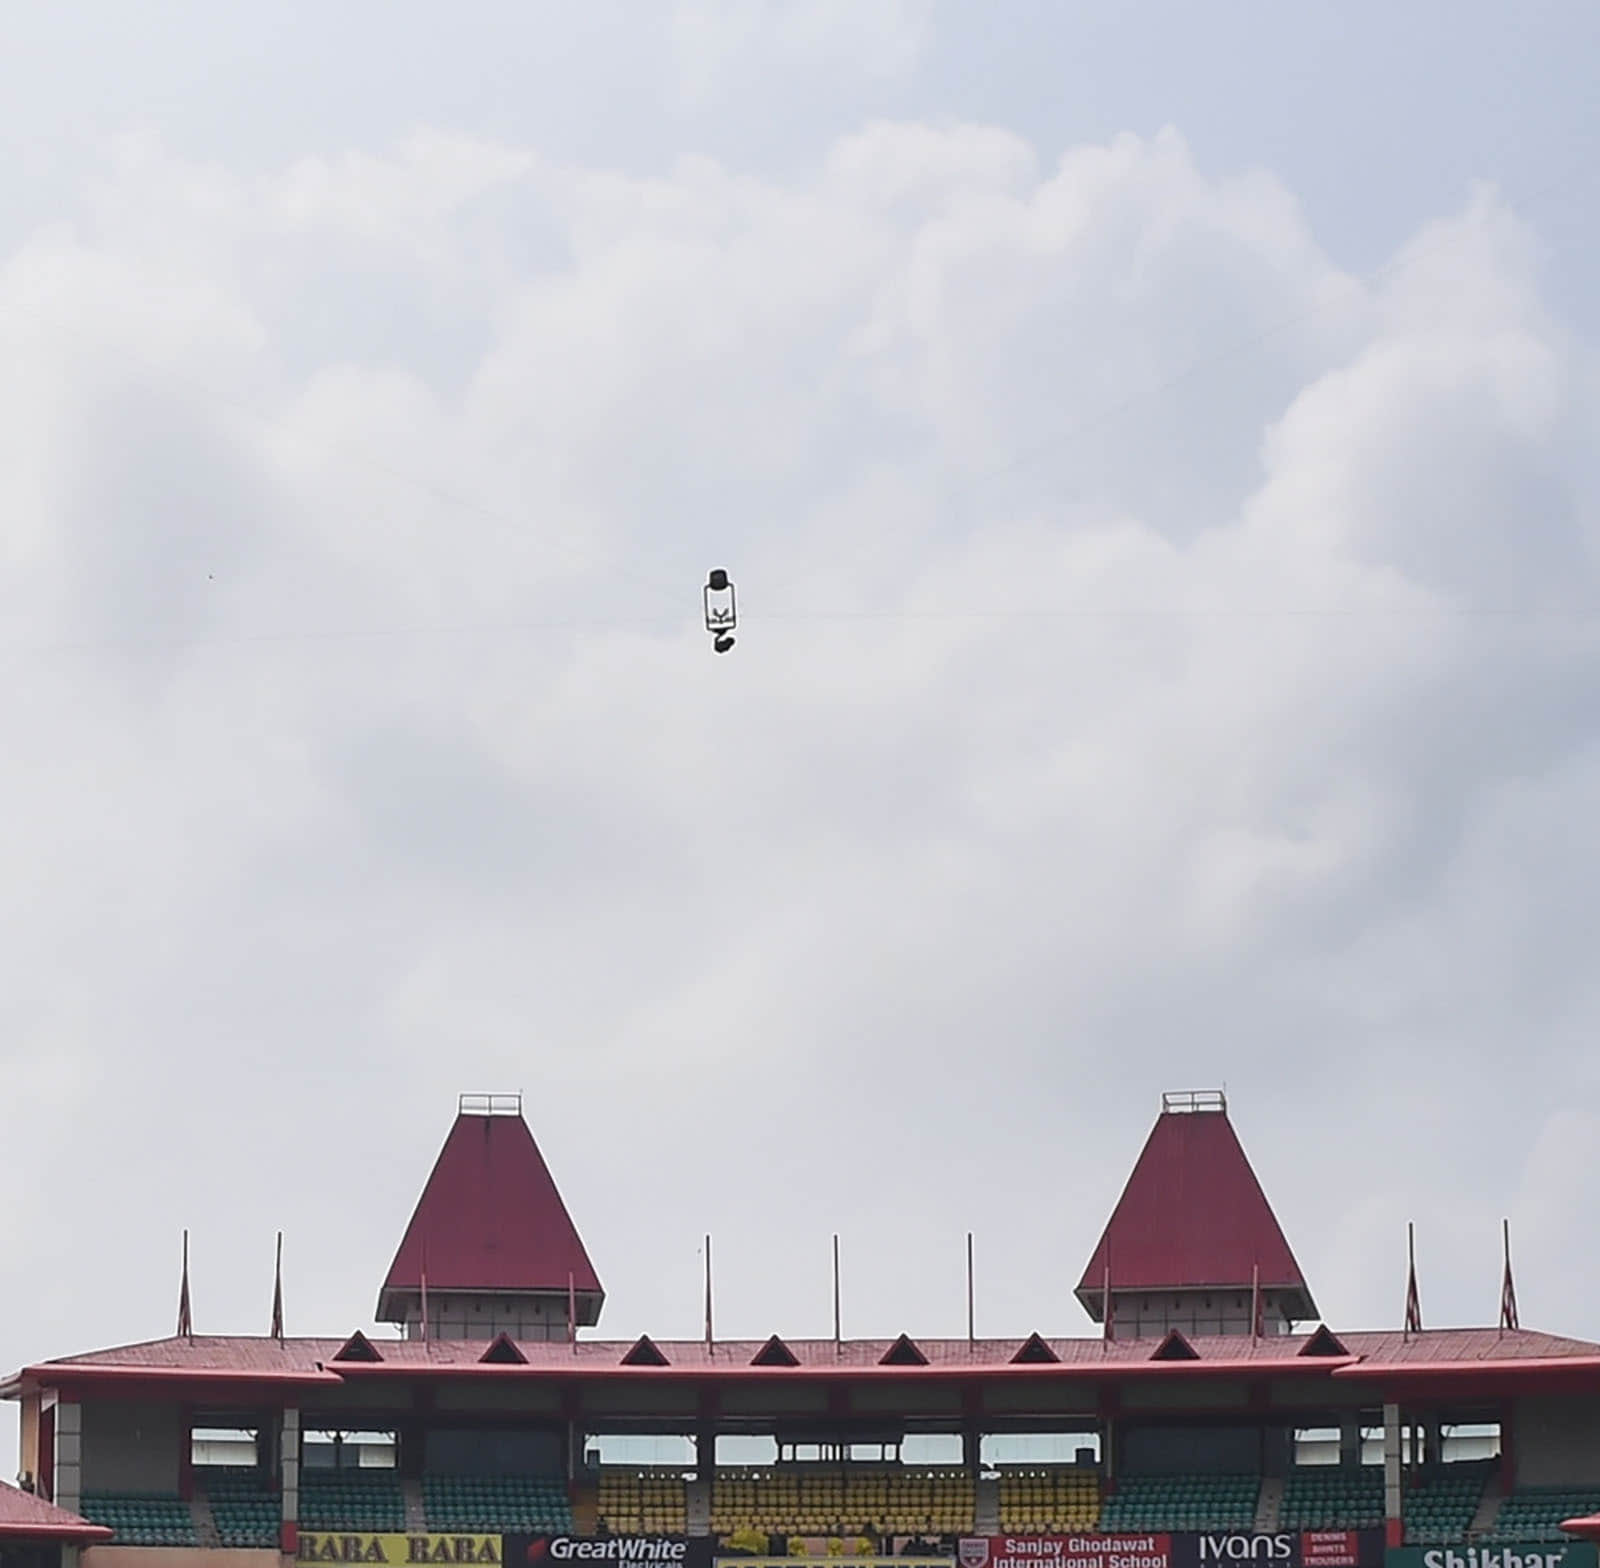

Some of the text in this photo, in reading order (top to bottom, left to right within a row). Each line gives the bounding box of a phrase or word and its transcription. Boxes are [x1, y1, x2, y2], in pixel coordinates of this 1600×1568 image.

[405, 1536, 501, 1563] BABA
[550, 1537, 686, 1560] GreatWhite
[1005, 1539, 1063, 1556] Sanjay
[1068, 1537, 1155, 1552] Ghodawat
[1109, 1554, 1167, 1568] School
